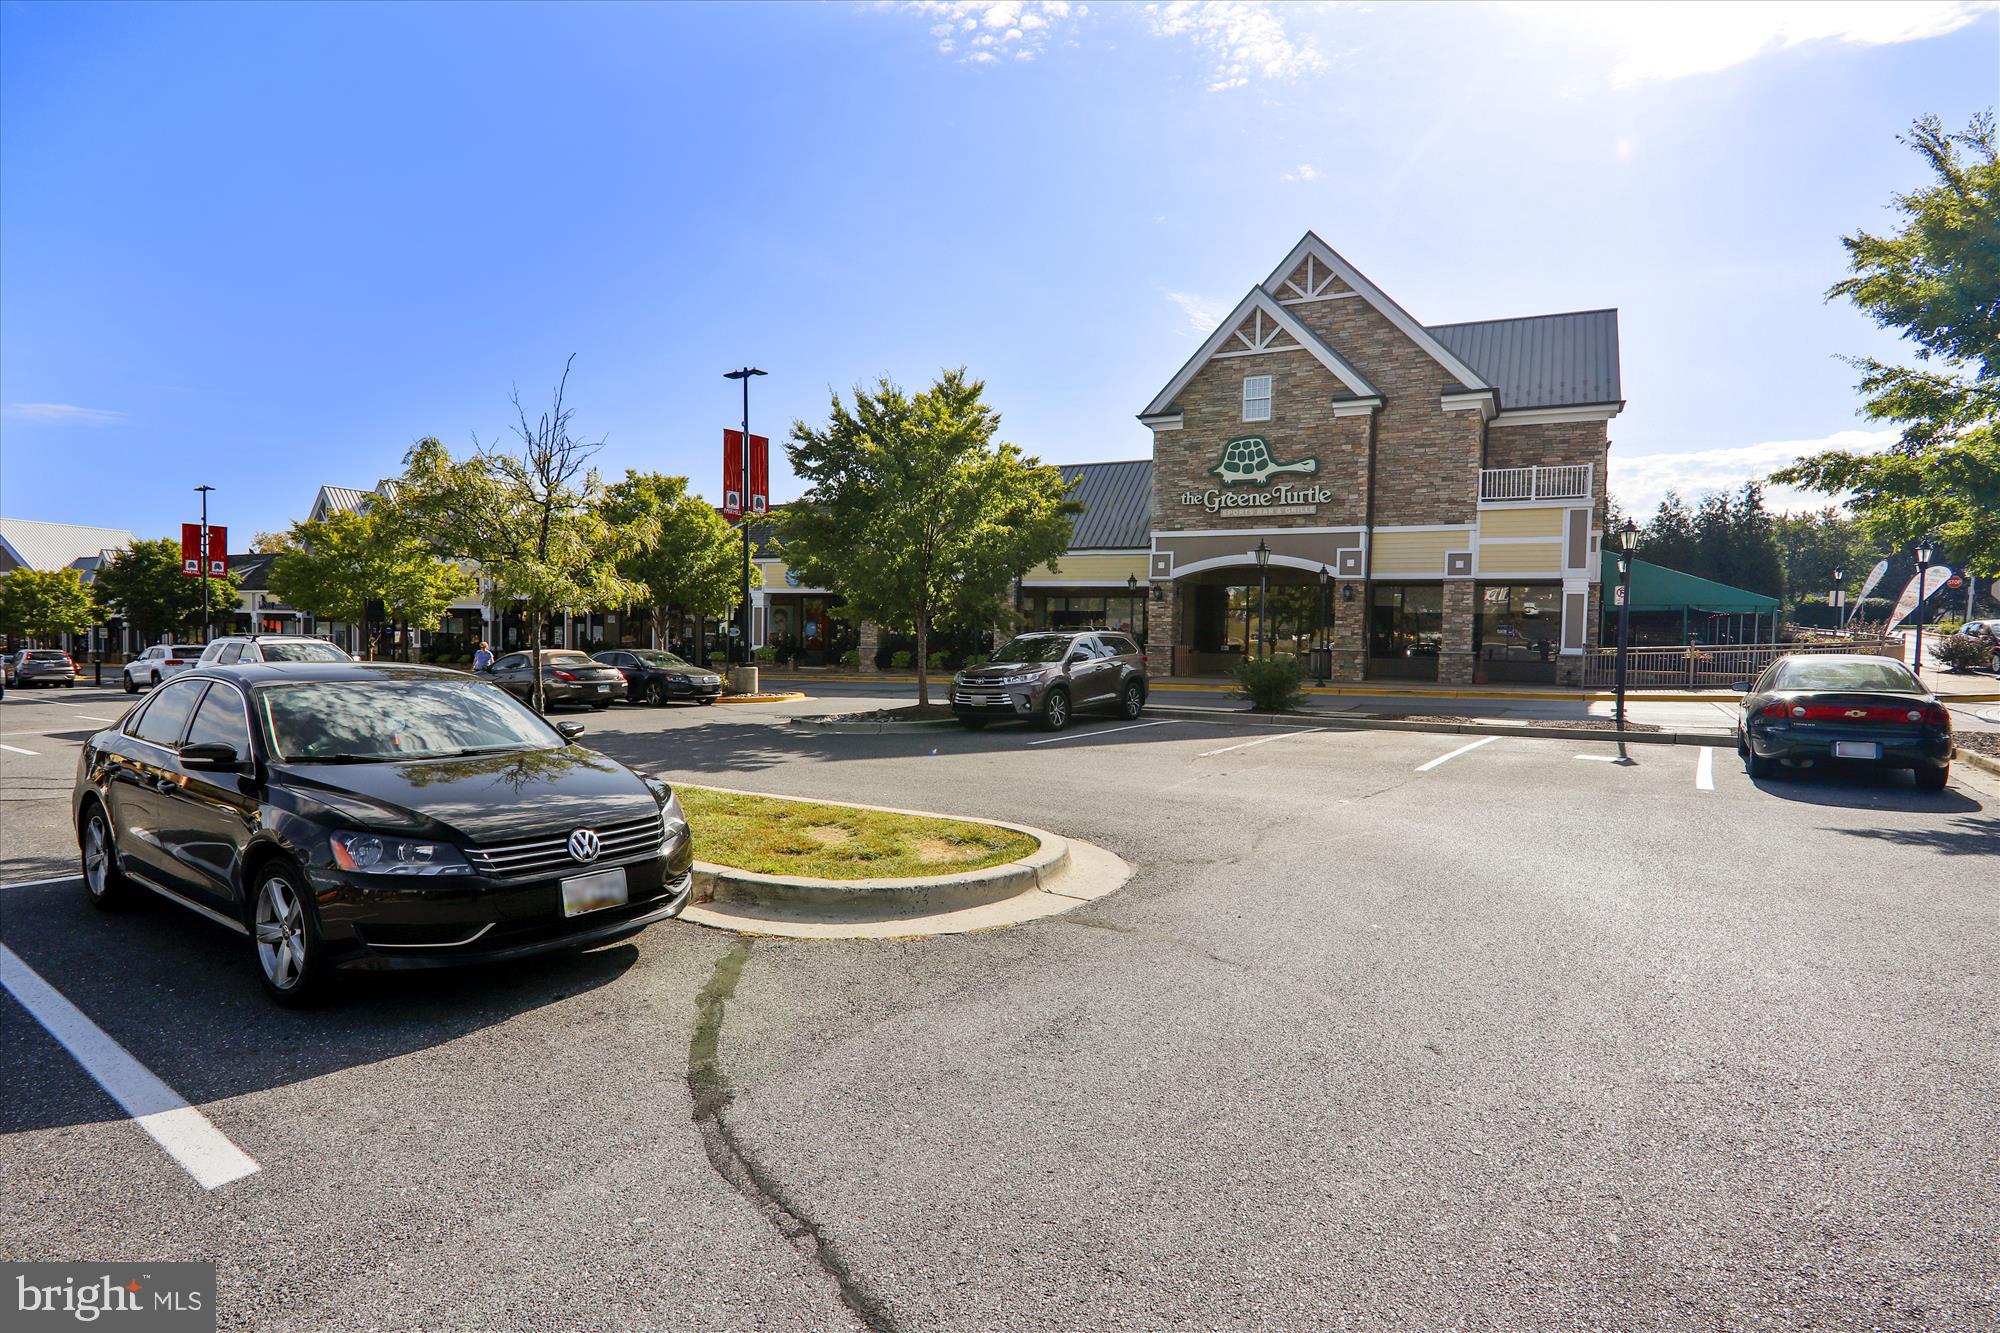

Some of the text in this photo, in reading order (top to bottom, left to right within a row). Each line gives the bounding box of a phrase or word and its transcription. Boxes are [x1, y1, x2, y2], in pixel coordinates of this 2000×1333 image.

[1181, 482, 1332, 513] the Greene Turtle
